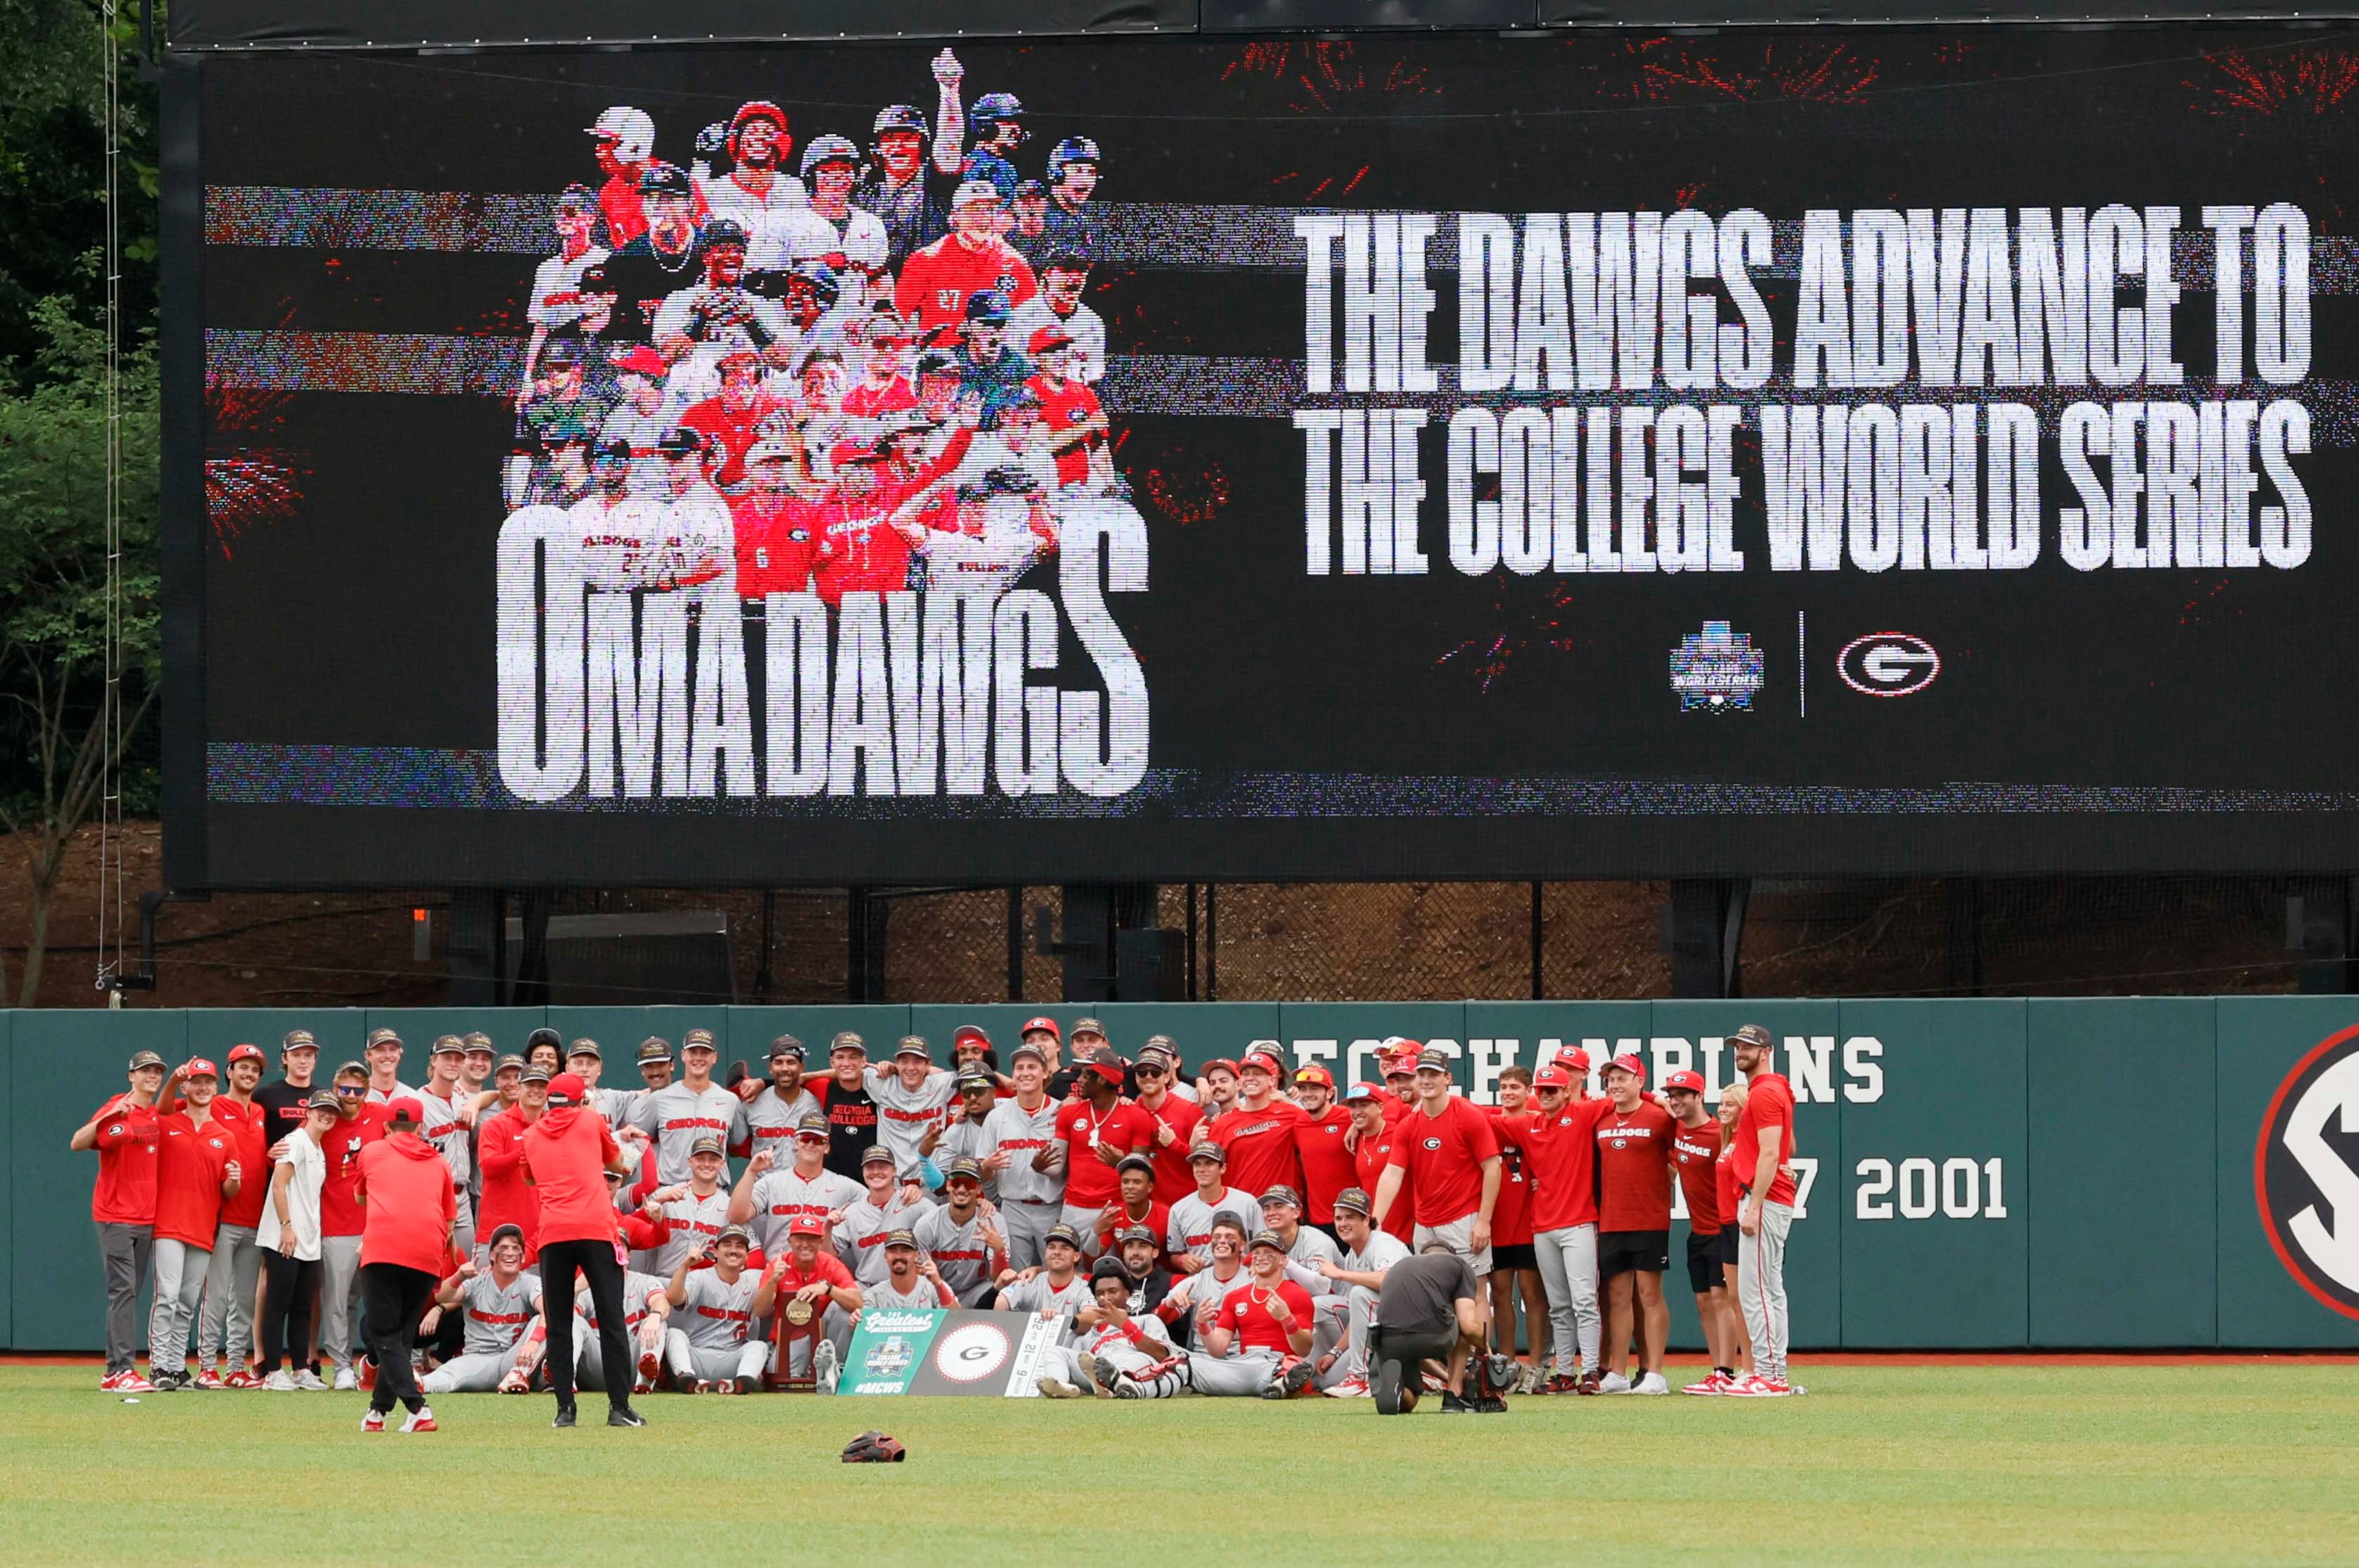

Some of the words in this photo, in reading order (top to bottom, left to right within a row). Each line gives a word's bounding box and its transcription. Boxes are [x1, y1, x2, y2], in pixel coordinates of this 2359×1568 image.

[1294, 215, 1438, 392] THE
[1458, 208, 1774, 391] DAWGS
[1794, 203, 2184, 386] ADVANCE
[2202, 202, 2312, 386] TO
[1293, 408, 1430, 574] THE
[1447, 403, 1743, 576] COLLEGE
[1760, 402, 2040, 573] WORLD
[2059, 400, 2312, 572] SERIES
[1598, 1128, 1651, 1139] BULLDOGS
[1425, 1138, 1440, 1149] G
[1612, 1139, 1625, 1149] G
[1856, 1158, 2007, 1219] 2001
[788, 1310, 812, 1319] NCAA
[960, 1346, 990, 1360] G
[1024, 1344, 1036, 1354] 12
[855, 1382, 904, 1394] #MCWS
